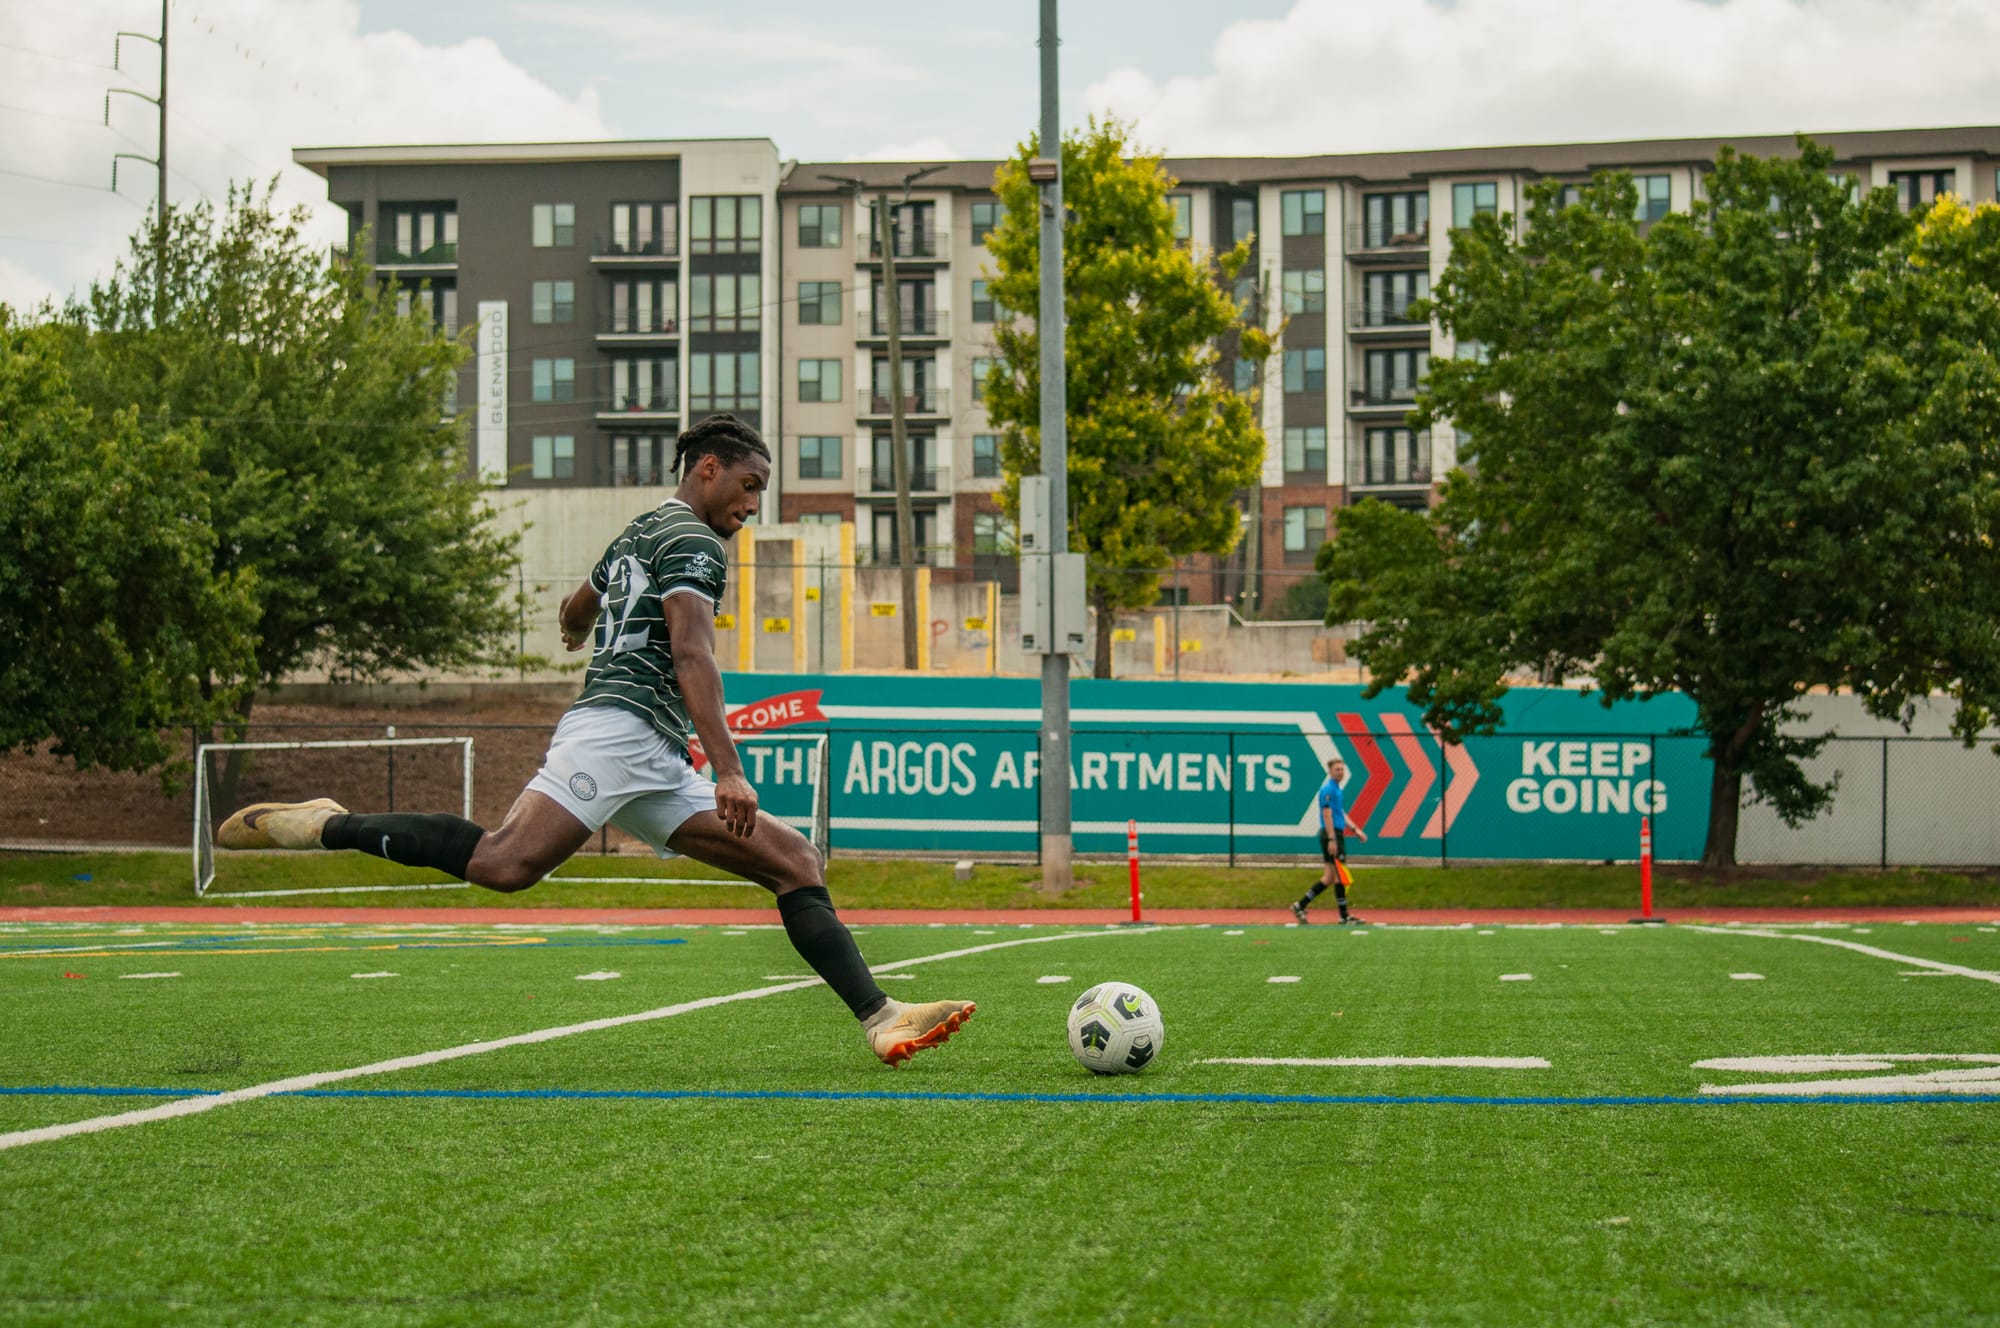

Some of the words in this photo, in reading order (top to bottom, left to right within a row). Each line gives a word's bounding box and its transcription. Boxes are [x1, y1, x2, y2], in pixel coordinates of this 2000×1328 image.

[492, 311, 503, 424] GLENWOOD
[685, 563, 712, 575] Soccer
[843, 741, 977, 796] ARGOS
[1522, 741, 1652, 777] KEEP
[1506, 777, 1668, 814] GOING
